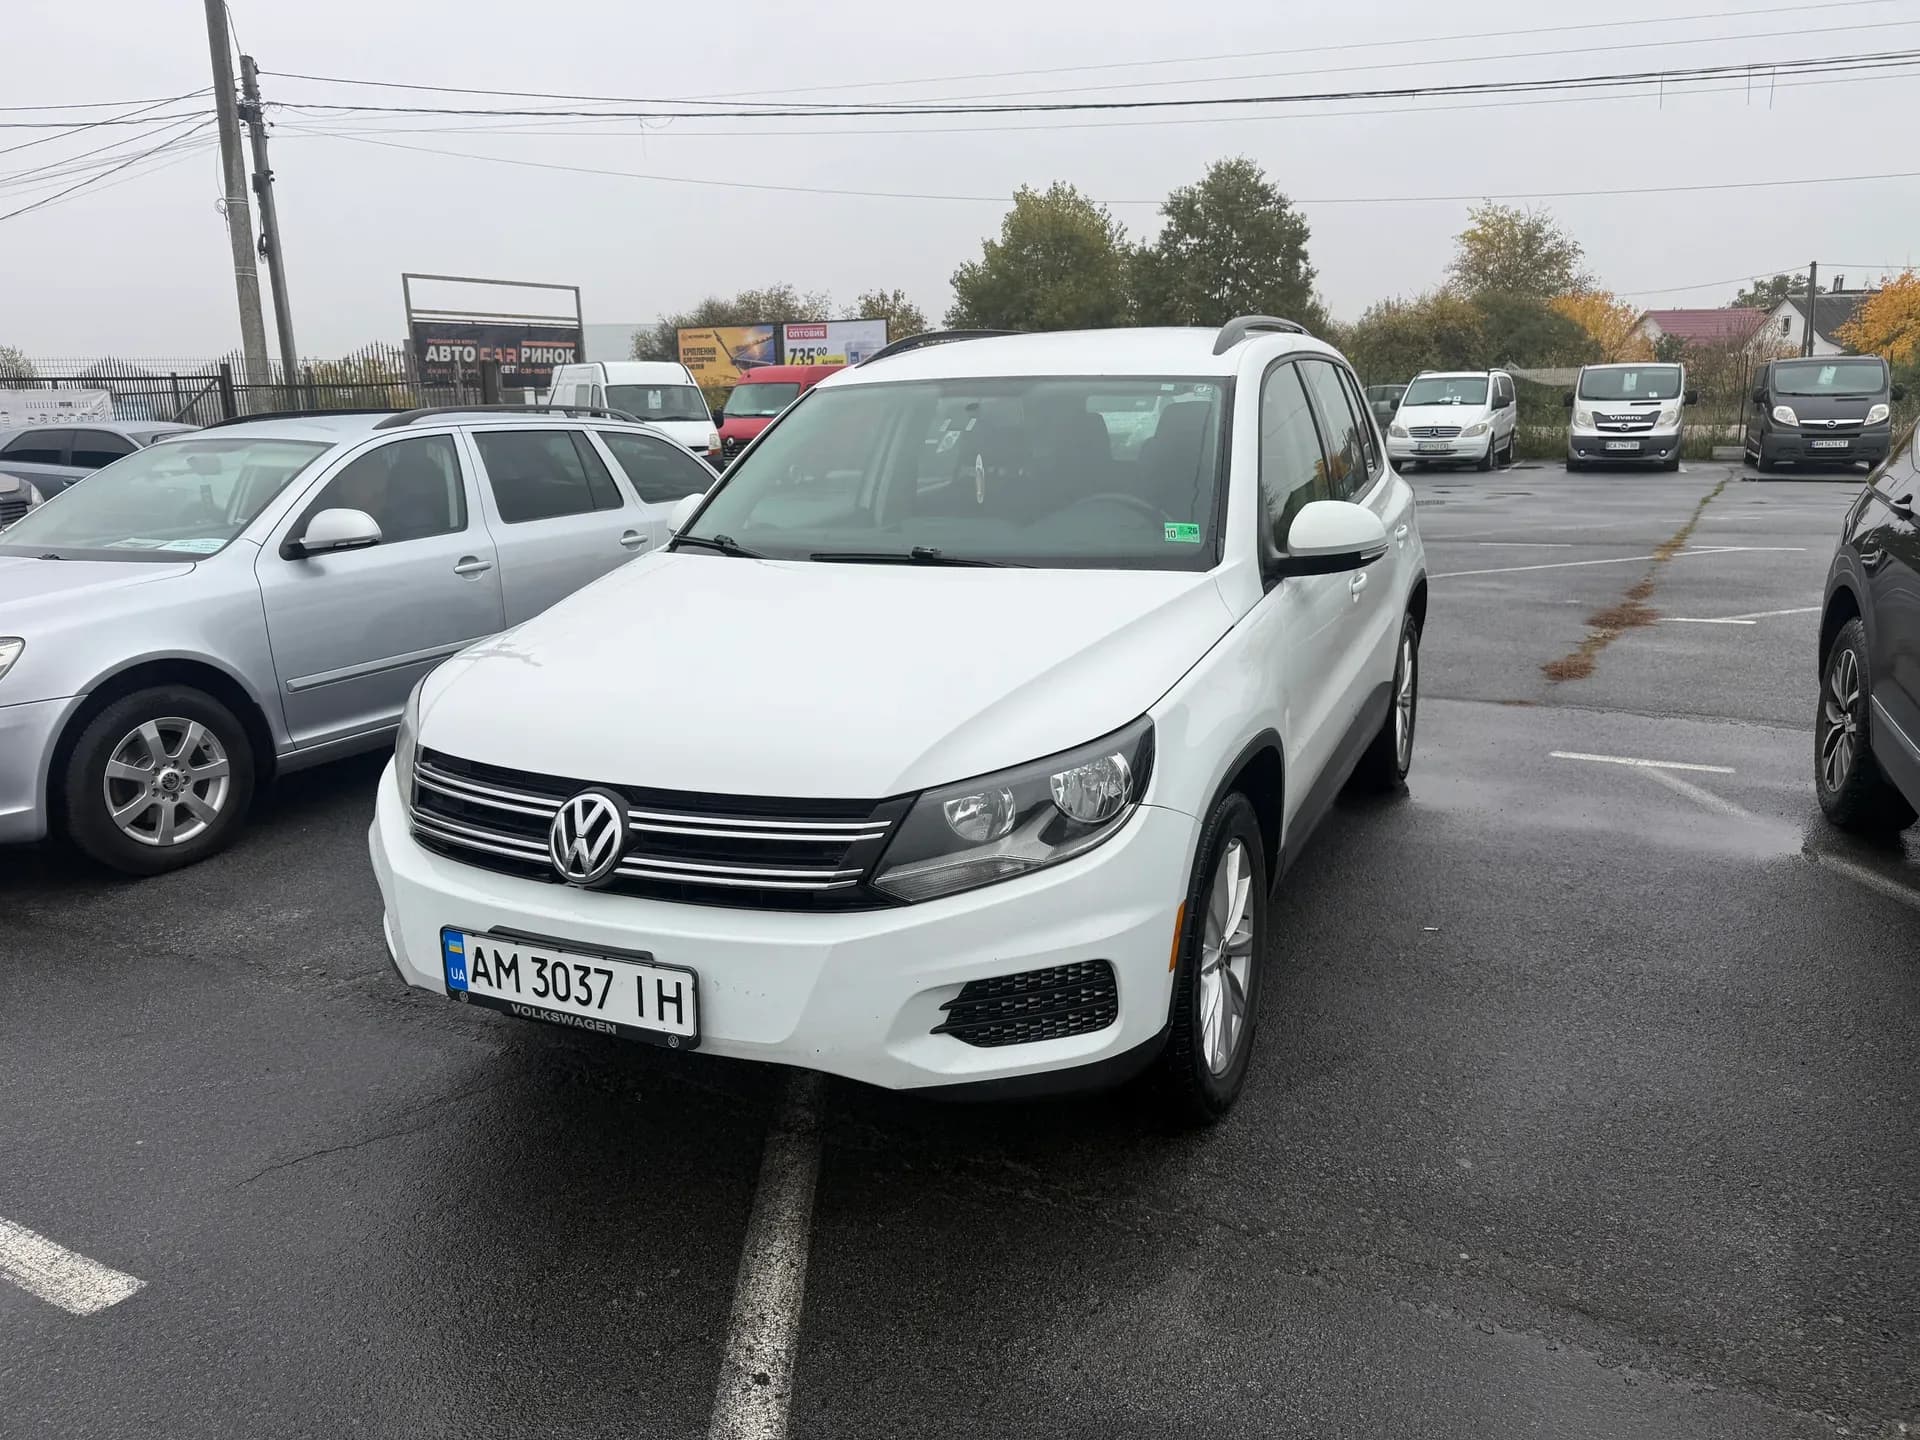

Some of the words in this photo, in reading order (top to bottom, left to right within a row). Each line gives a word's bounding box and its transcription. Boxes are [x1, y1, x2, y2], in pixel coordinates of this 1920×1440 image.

[788, 330, 825, 338] ОПТОВИК
[425, 345, 476, 362] АВТО
[521, 347, 576, 363] РИНОК
[789, 347, 815, 365] 735
[1167, 529, 1176, 538] 10
[450, 967, 466, 983] UA
[471, 946, 521, 993] AM
[530, 956, 613, 1009] 3037
[636, 975, 684, 1025] IH
[511, 1003, 617, 1035] VOLKSWAGEN
